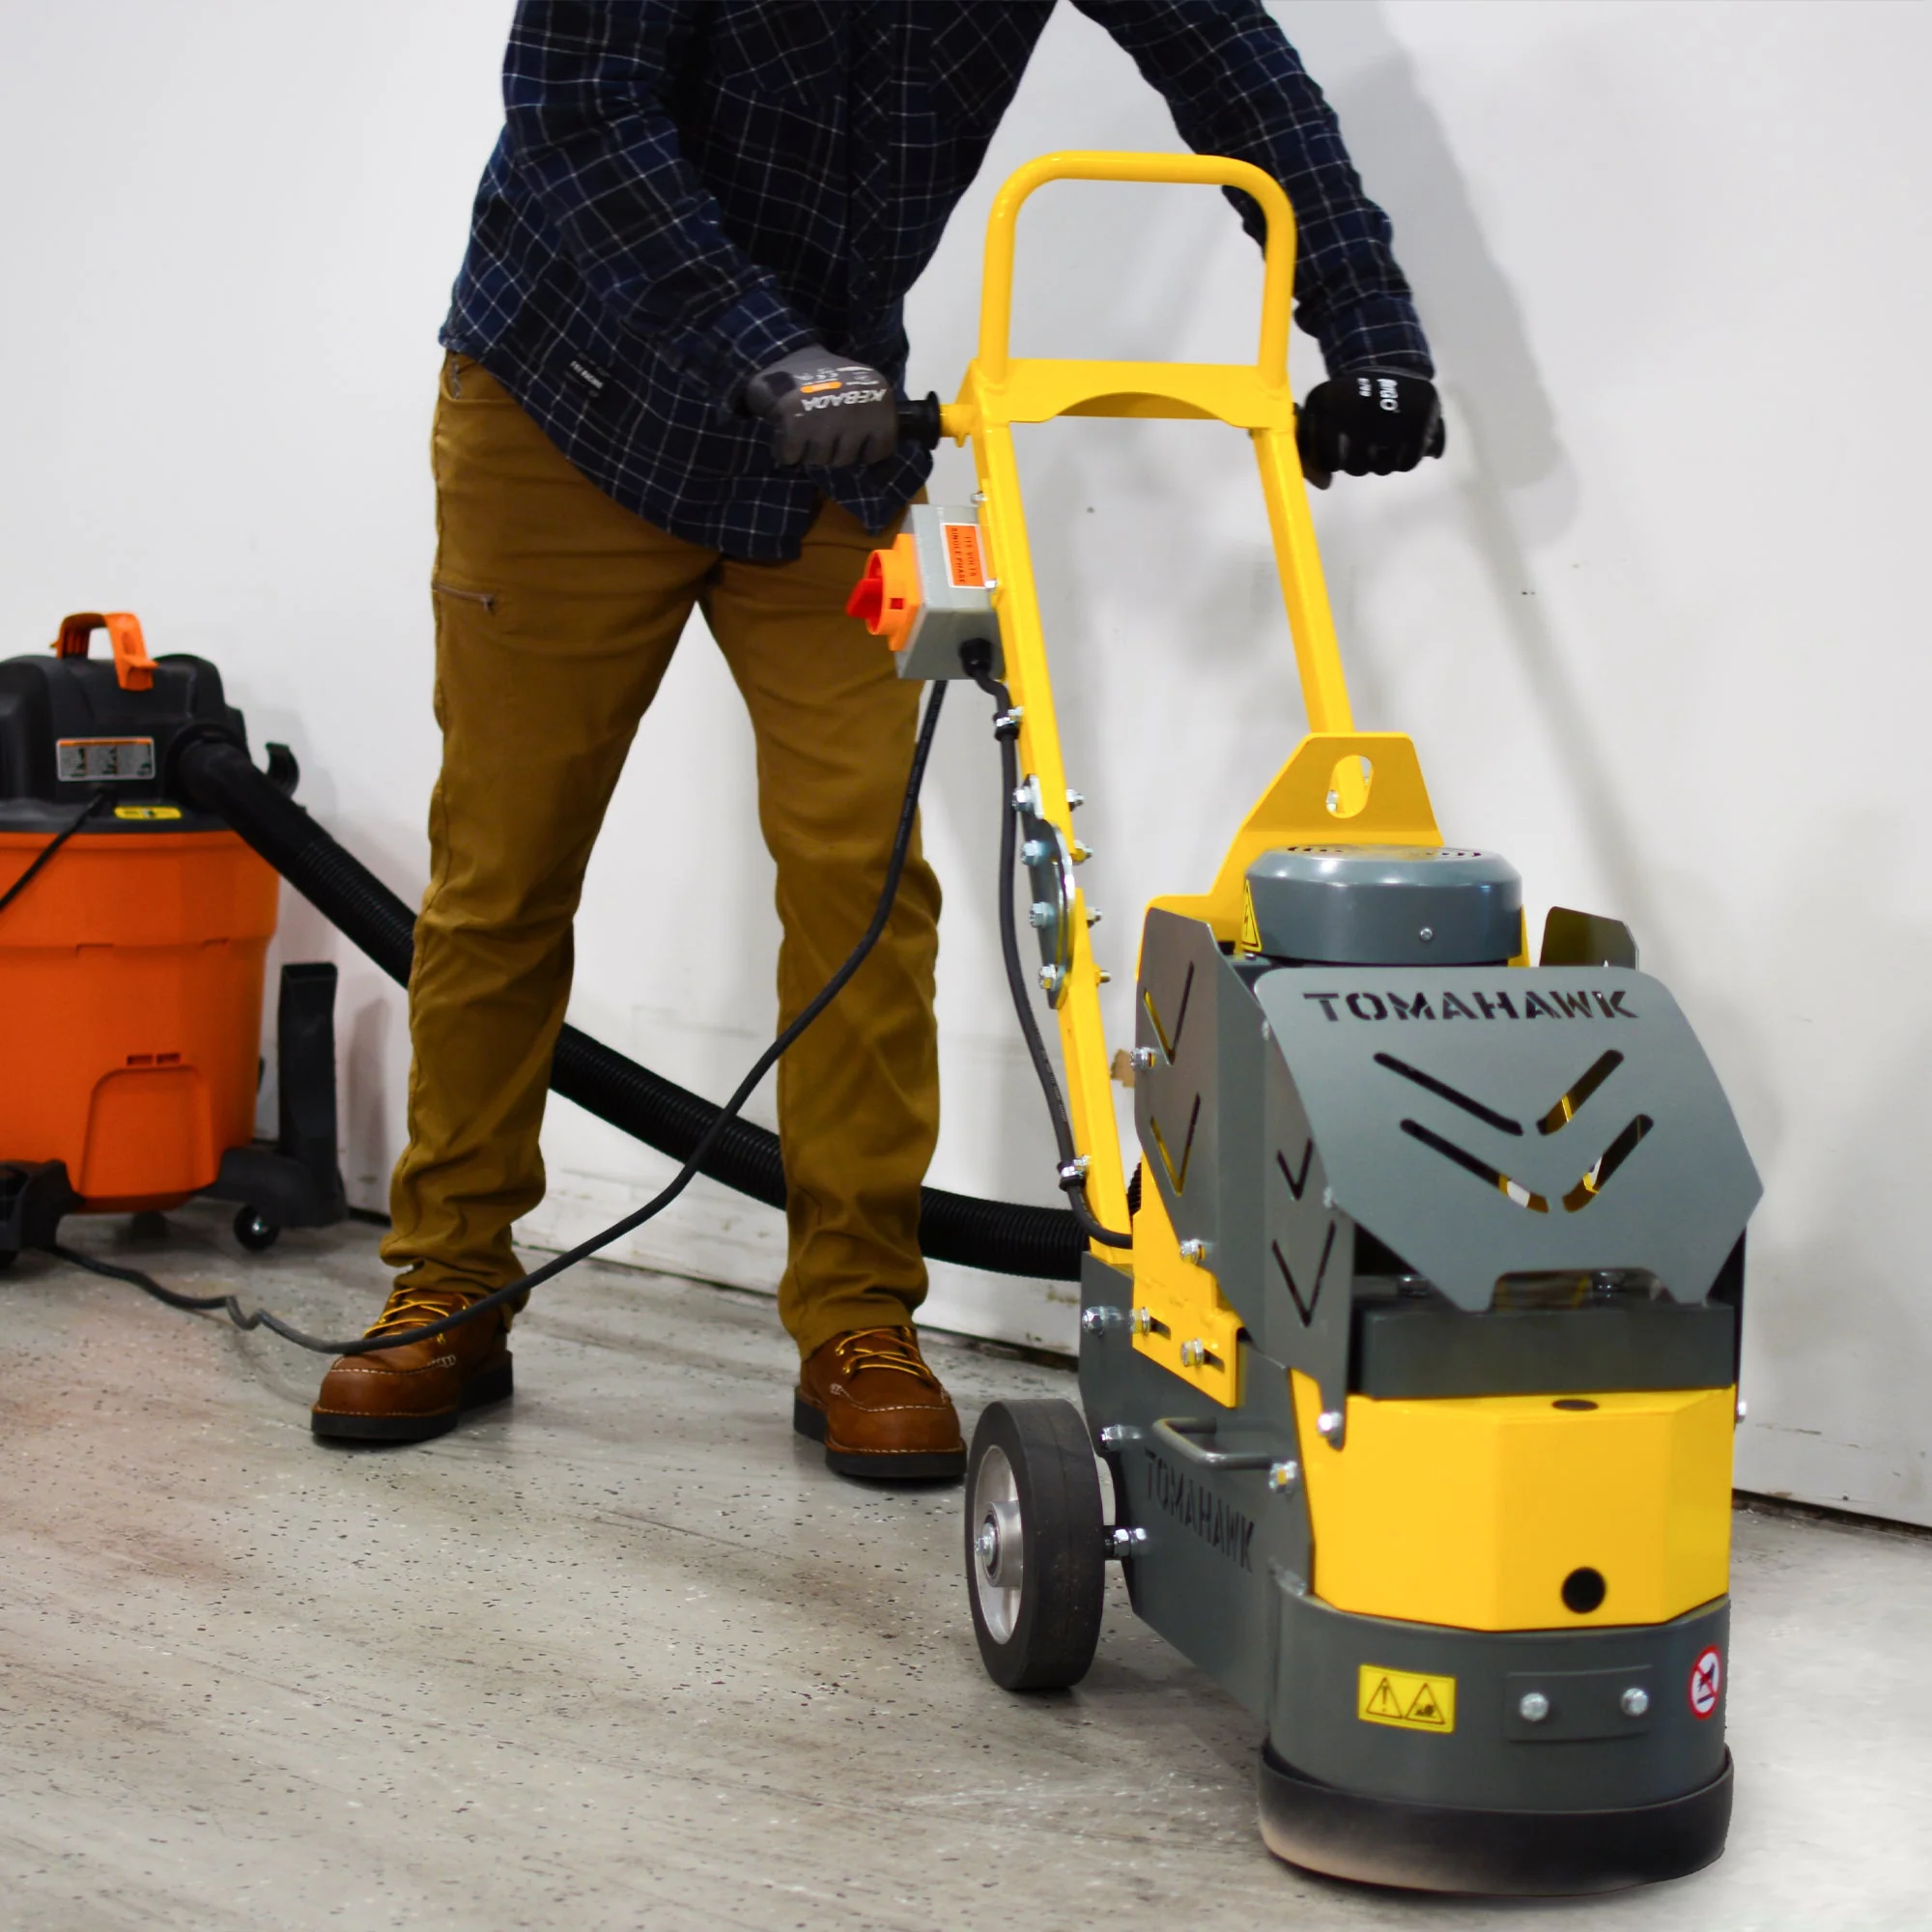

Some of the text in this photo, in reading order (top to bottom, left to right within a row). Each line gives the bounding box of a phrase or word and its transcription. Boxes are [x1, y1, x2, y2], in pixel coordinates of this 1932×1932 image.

[801, 388, 887, 412] KEBADA
[1302, 991, 1639, 1022] TOMAHAWK
[1145, 1446, 1255, 1574] TOMAHAWK
